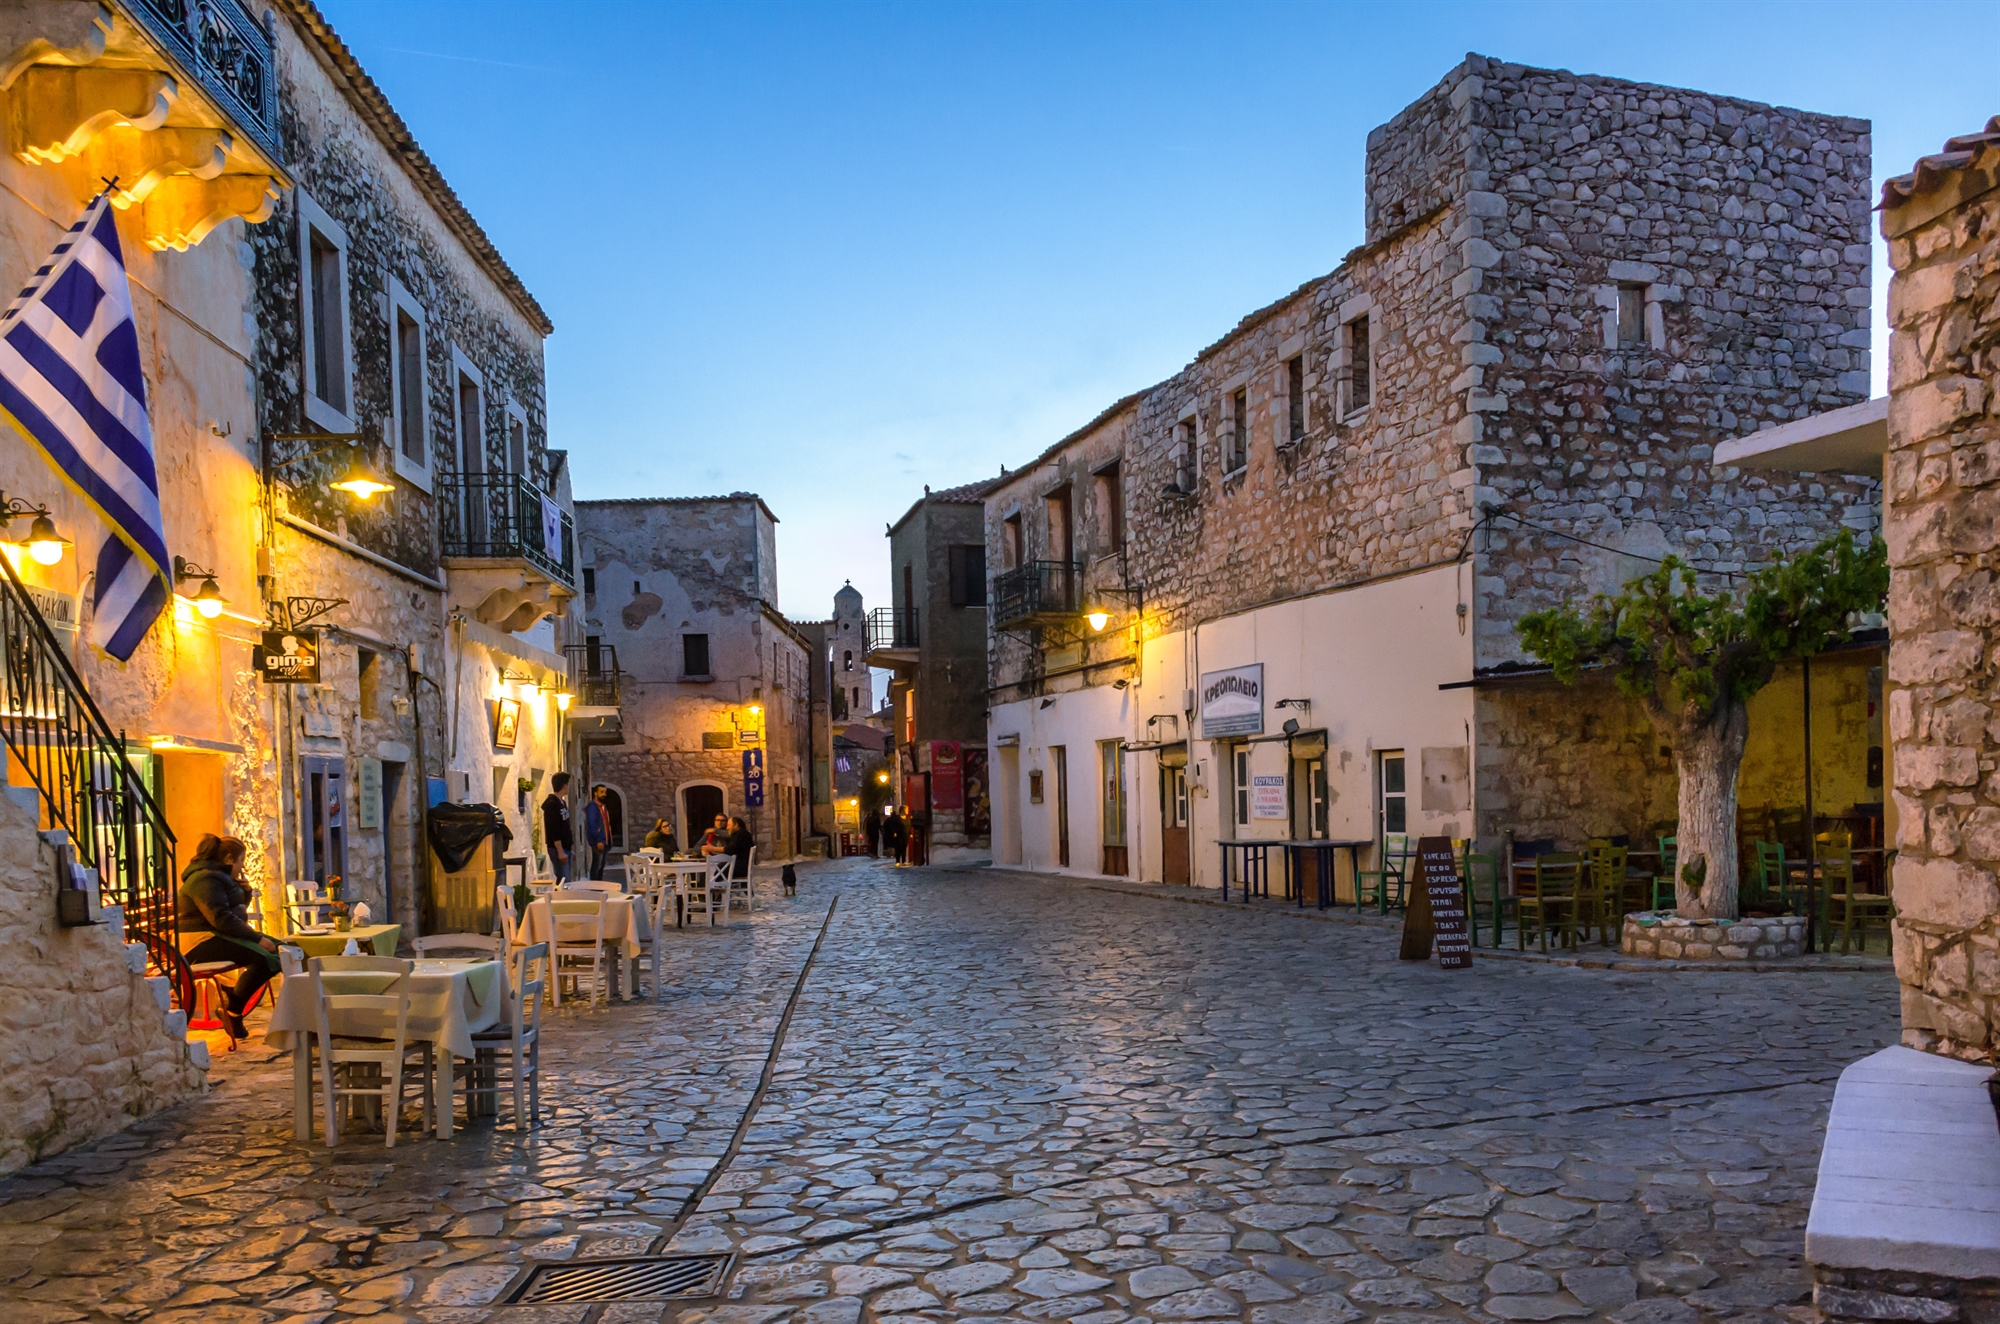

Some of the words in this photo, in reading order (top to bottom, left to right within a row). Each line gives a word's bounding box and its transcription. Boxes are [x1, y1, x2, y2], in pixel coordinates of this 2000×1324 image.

[266, 656, 315, 669] gima
[1204, 675, 1258, 704] ΚΡΕΟΠΩΛΕΙΟ
[748, 770, 760, 778] 20
[749, 783, 759, 796] P
[1434, 921, 1459, 929] TOAST
